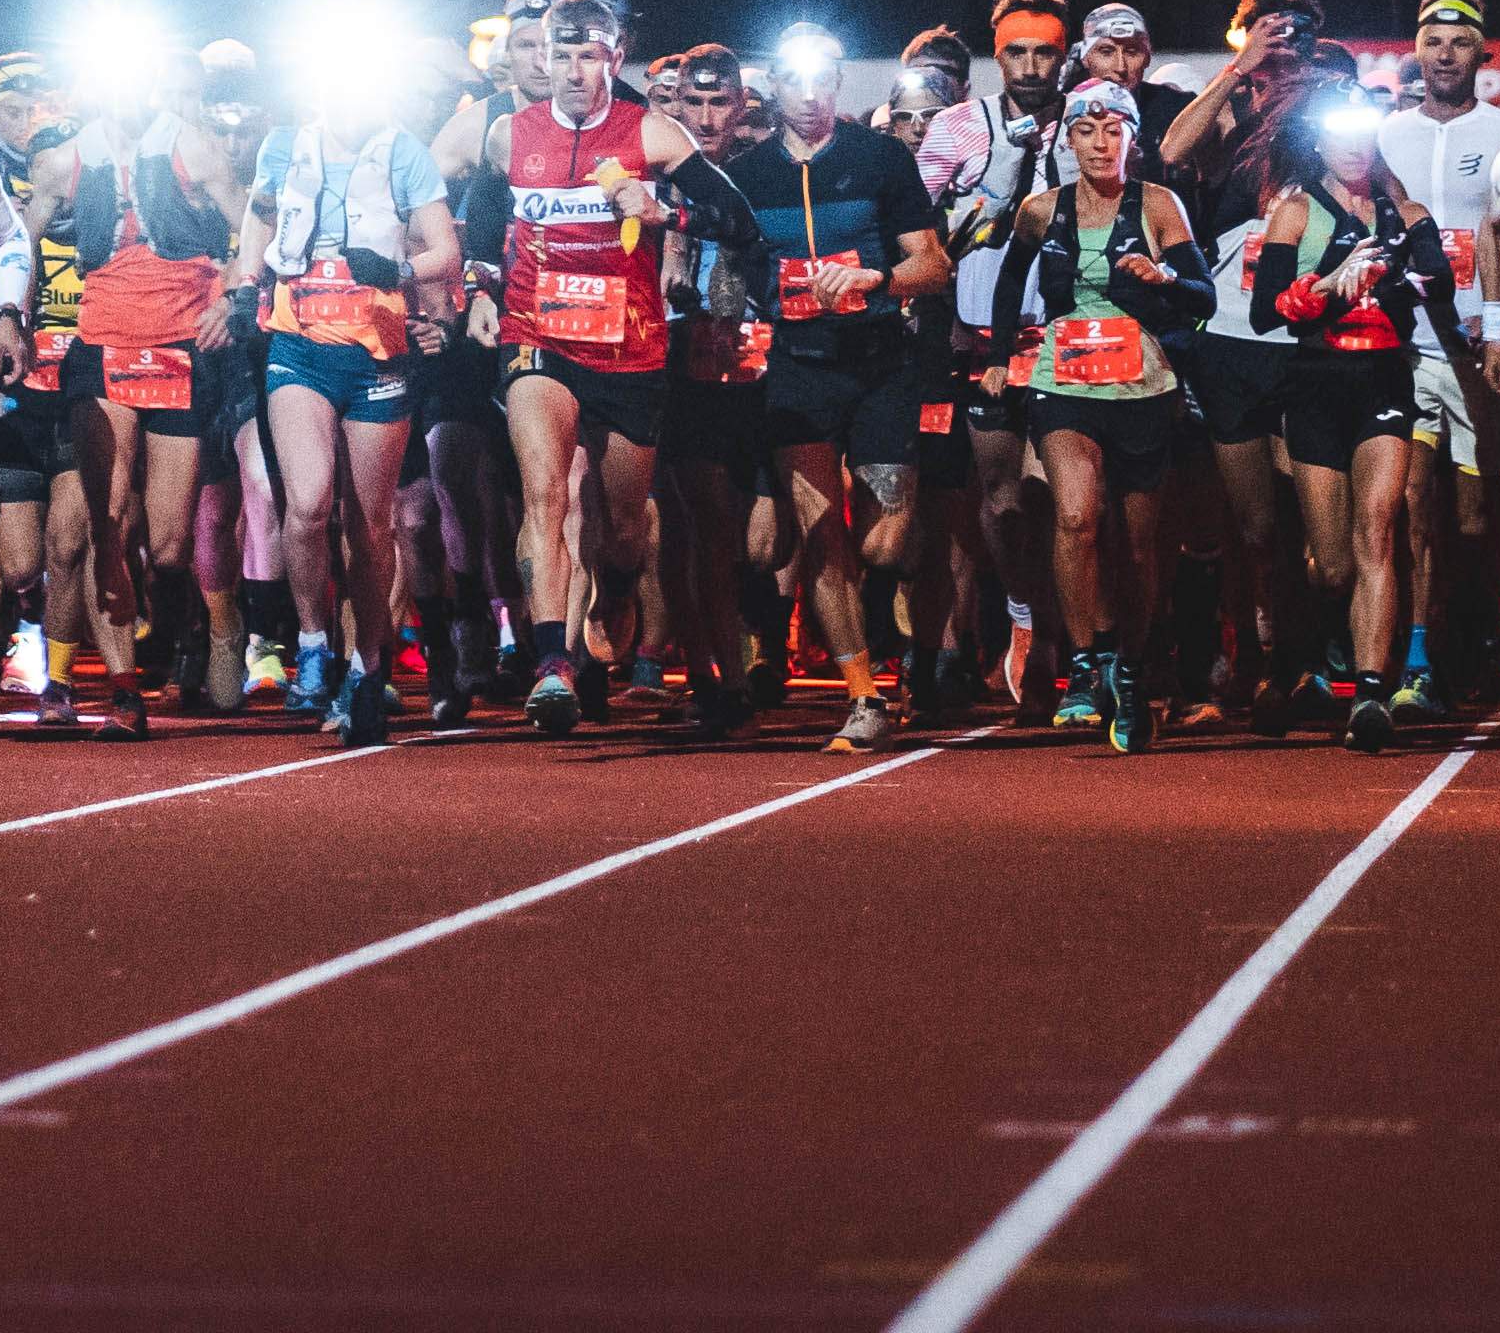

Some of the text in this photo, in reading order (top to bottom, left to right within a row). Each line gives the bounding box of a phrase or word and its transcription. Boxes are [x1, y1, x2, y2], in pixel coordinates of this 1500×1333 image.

[549, 198, 613, 216] Avanz
[322, 261, 337, 278] 6
[555, 274, 606, 295] 1279
[1088, 320, 1102, 338] 2
[139, 349, 153, 365] 3
